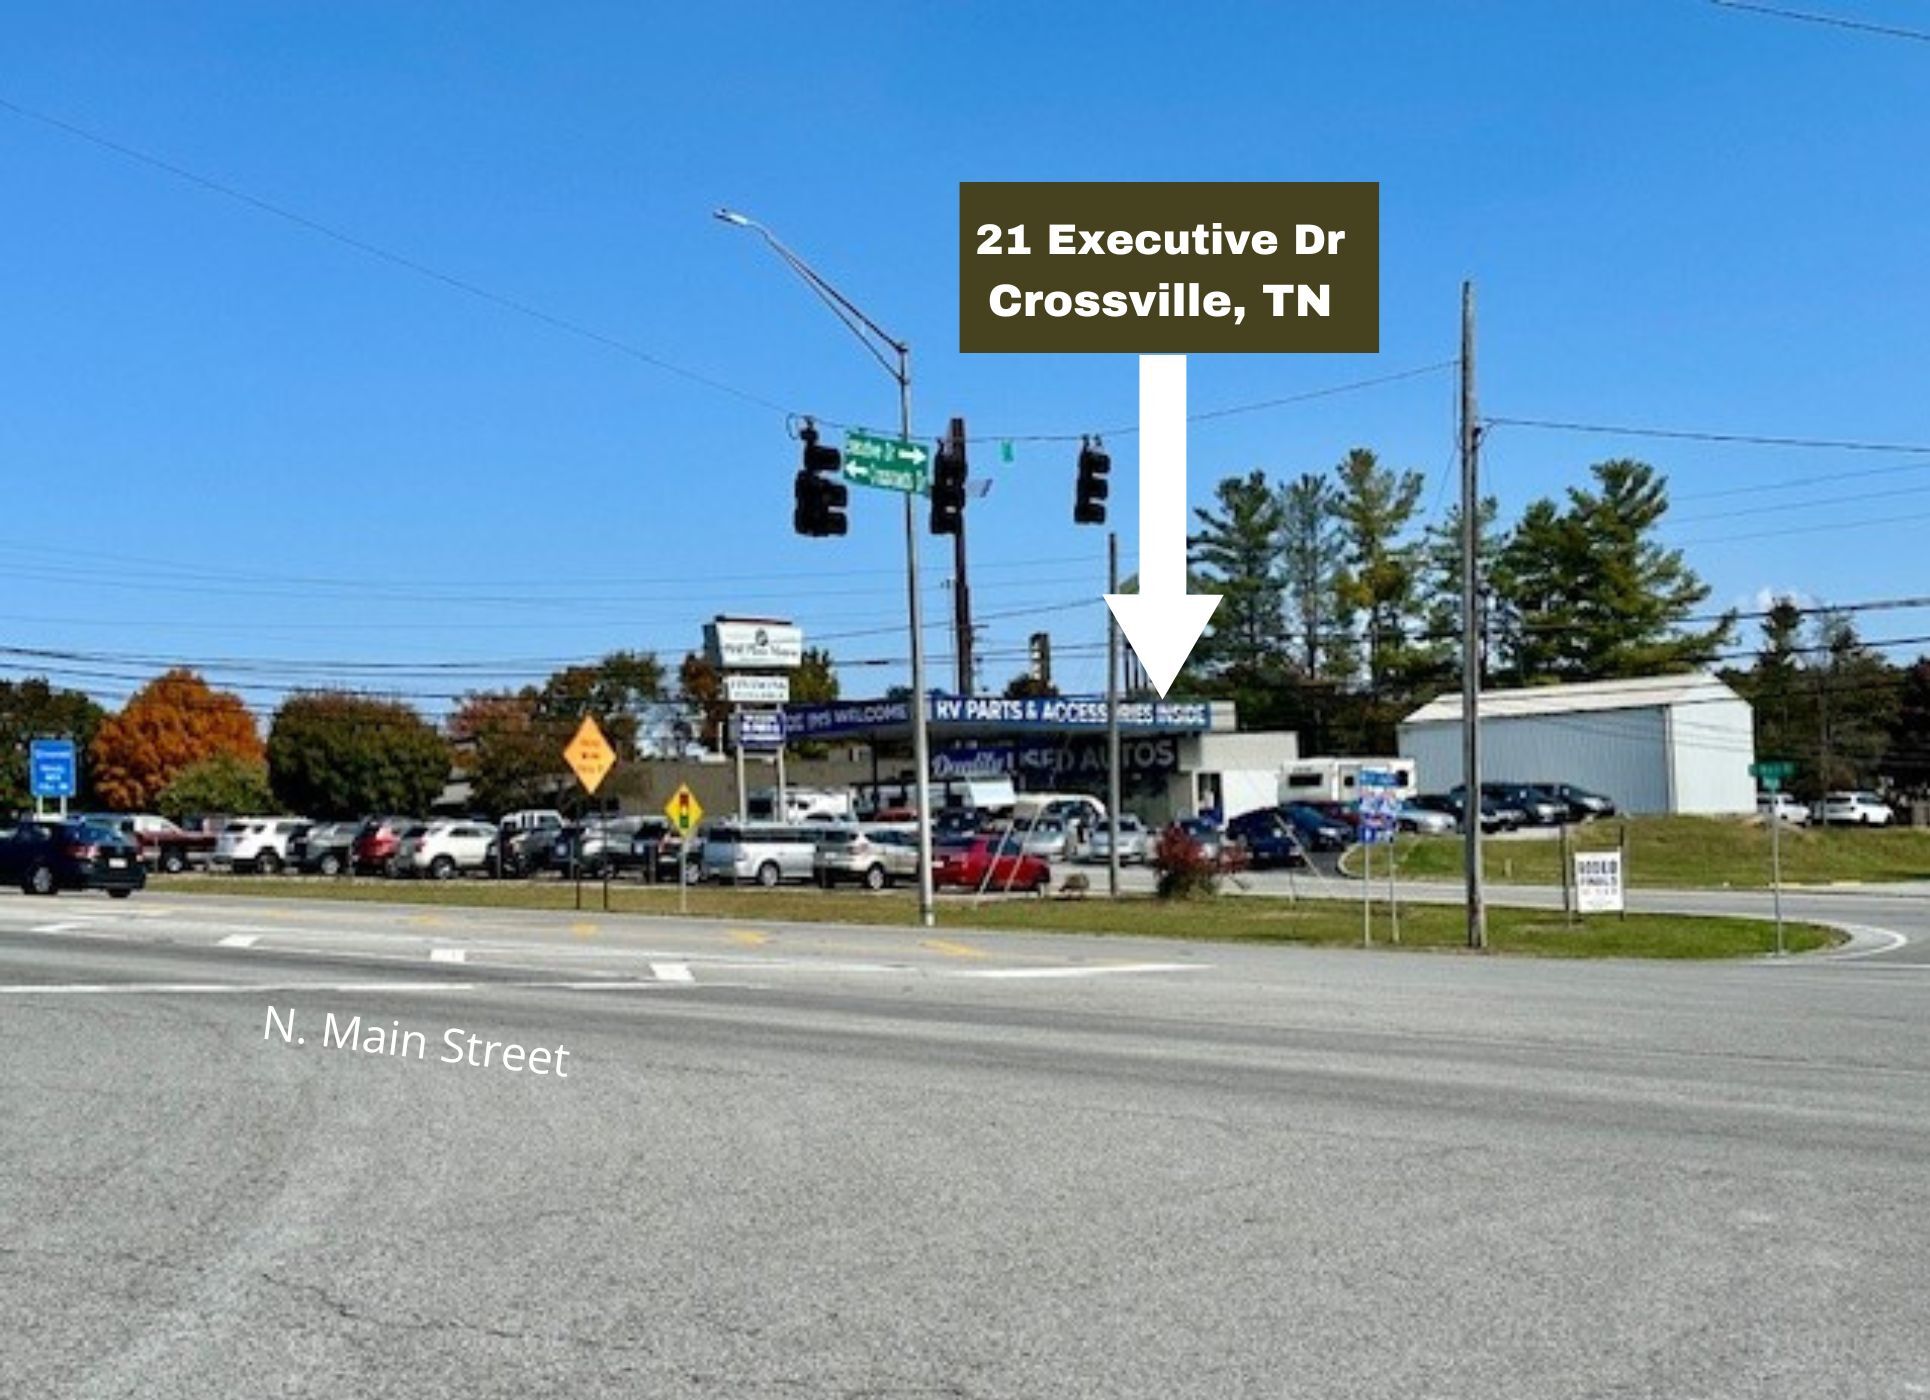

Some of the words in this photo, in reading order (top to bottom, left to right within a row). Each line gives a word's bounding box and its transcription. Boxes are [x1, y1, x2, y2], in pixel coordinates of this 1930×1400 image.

[936, 699, 962, 720] RV
[965, 699, 1024, 721] PARTS
[1025, 700, 1038, 720] &
[1043, 700, 1155, 725] ACCESSRIES
